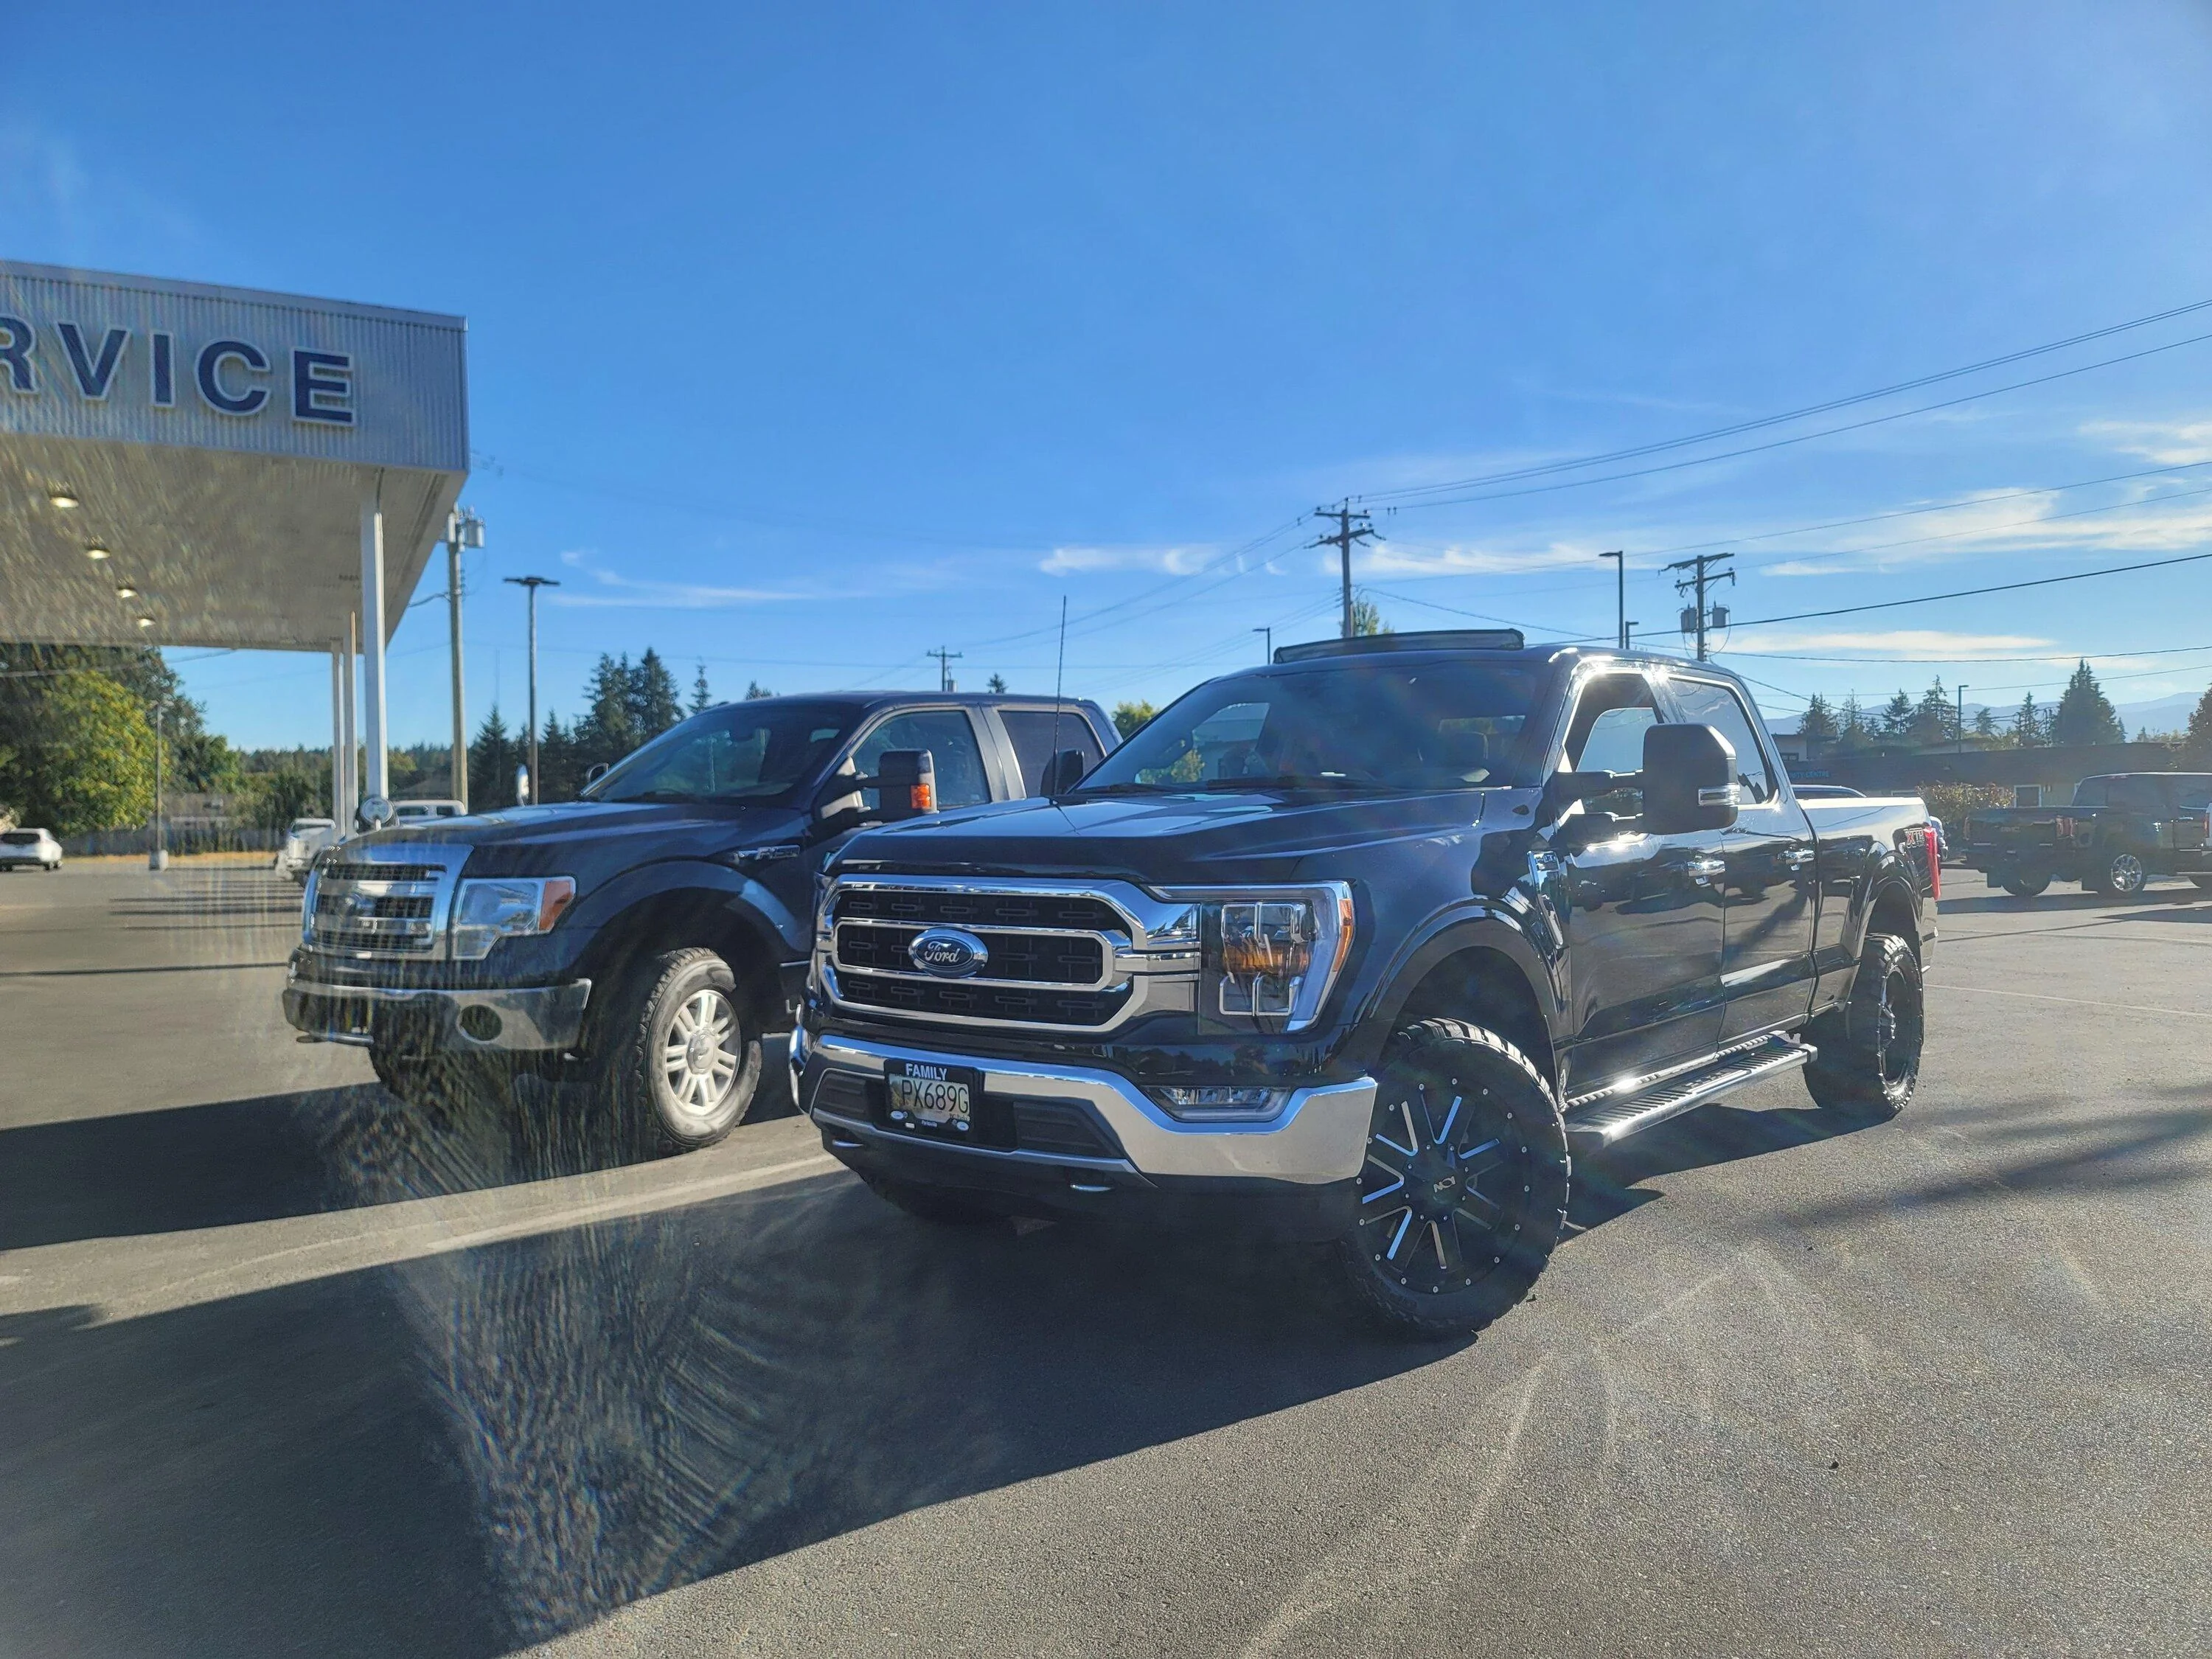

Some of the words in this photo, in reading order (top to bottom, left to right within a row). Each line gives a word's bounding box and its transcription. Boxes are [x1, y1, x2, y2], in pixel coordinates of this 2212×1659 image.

[925, 941, 960, 962] Ford
[905, 1062, 947, 1081] FAMILY
[901, 1079, 969, 1113] PX689G
